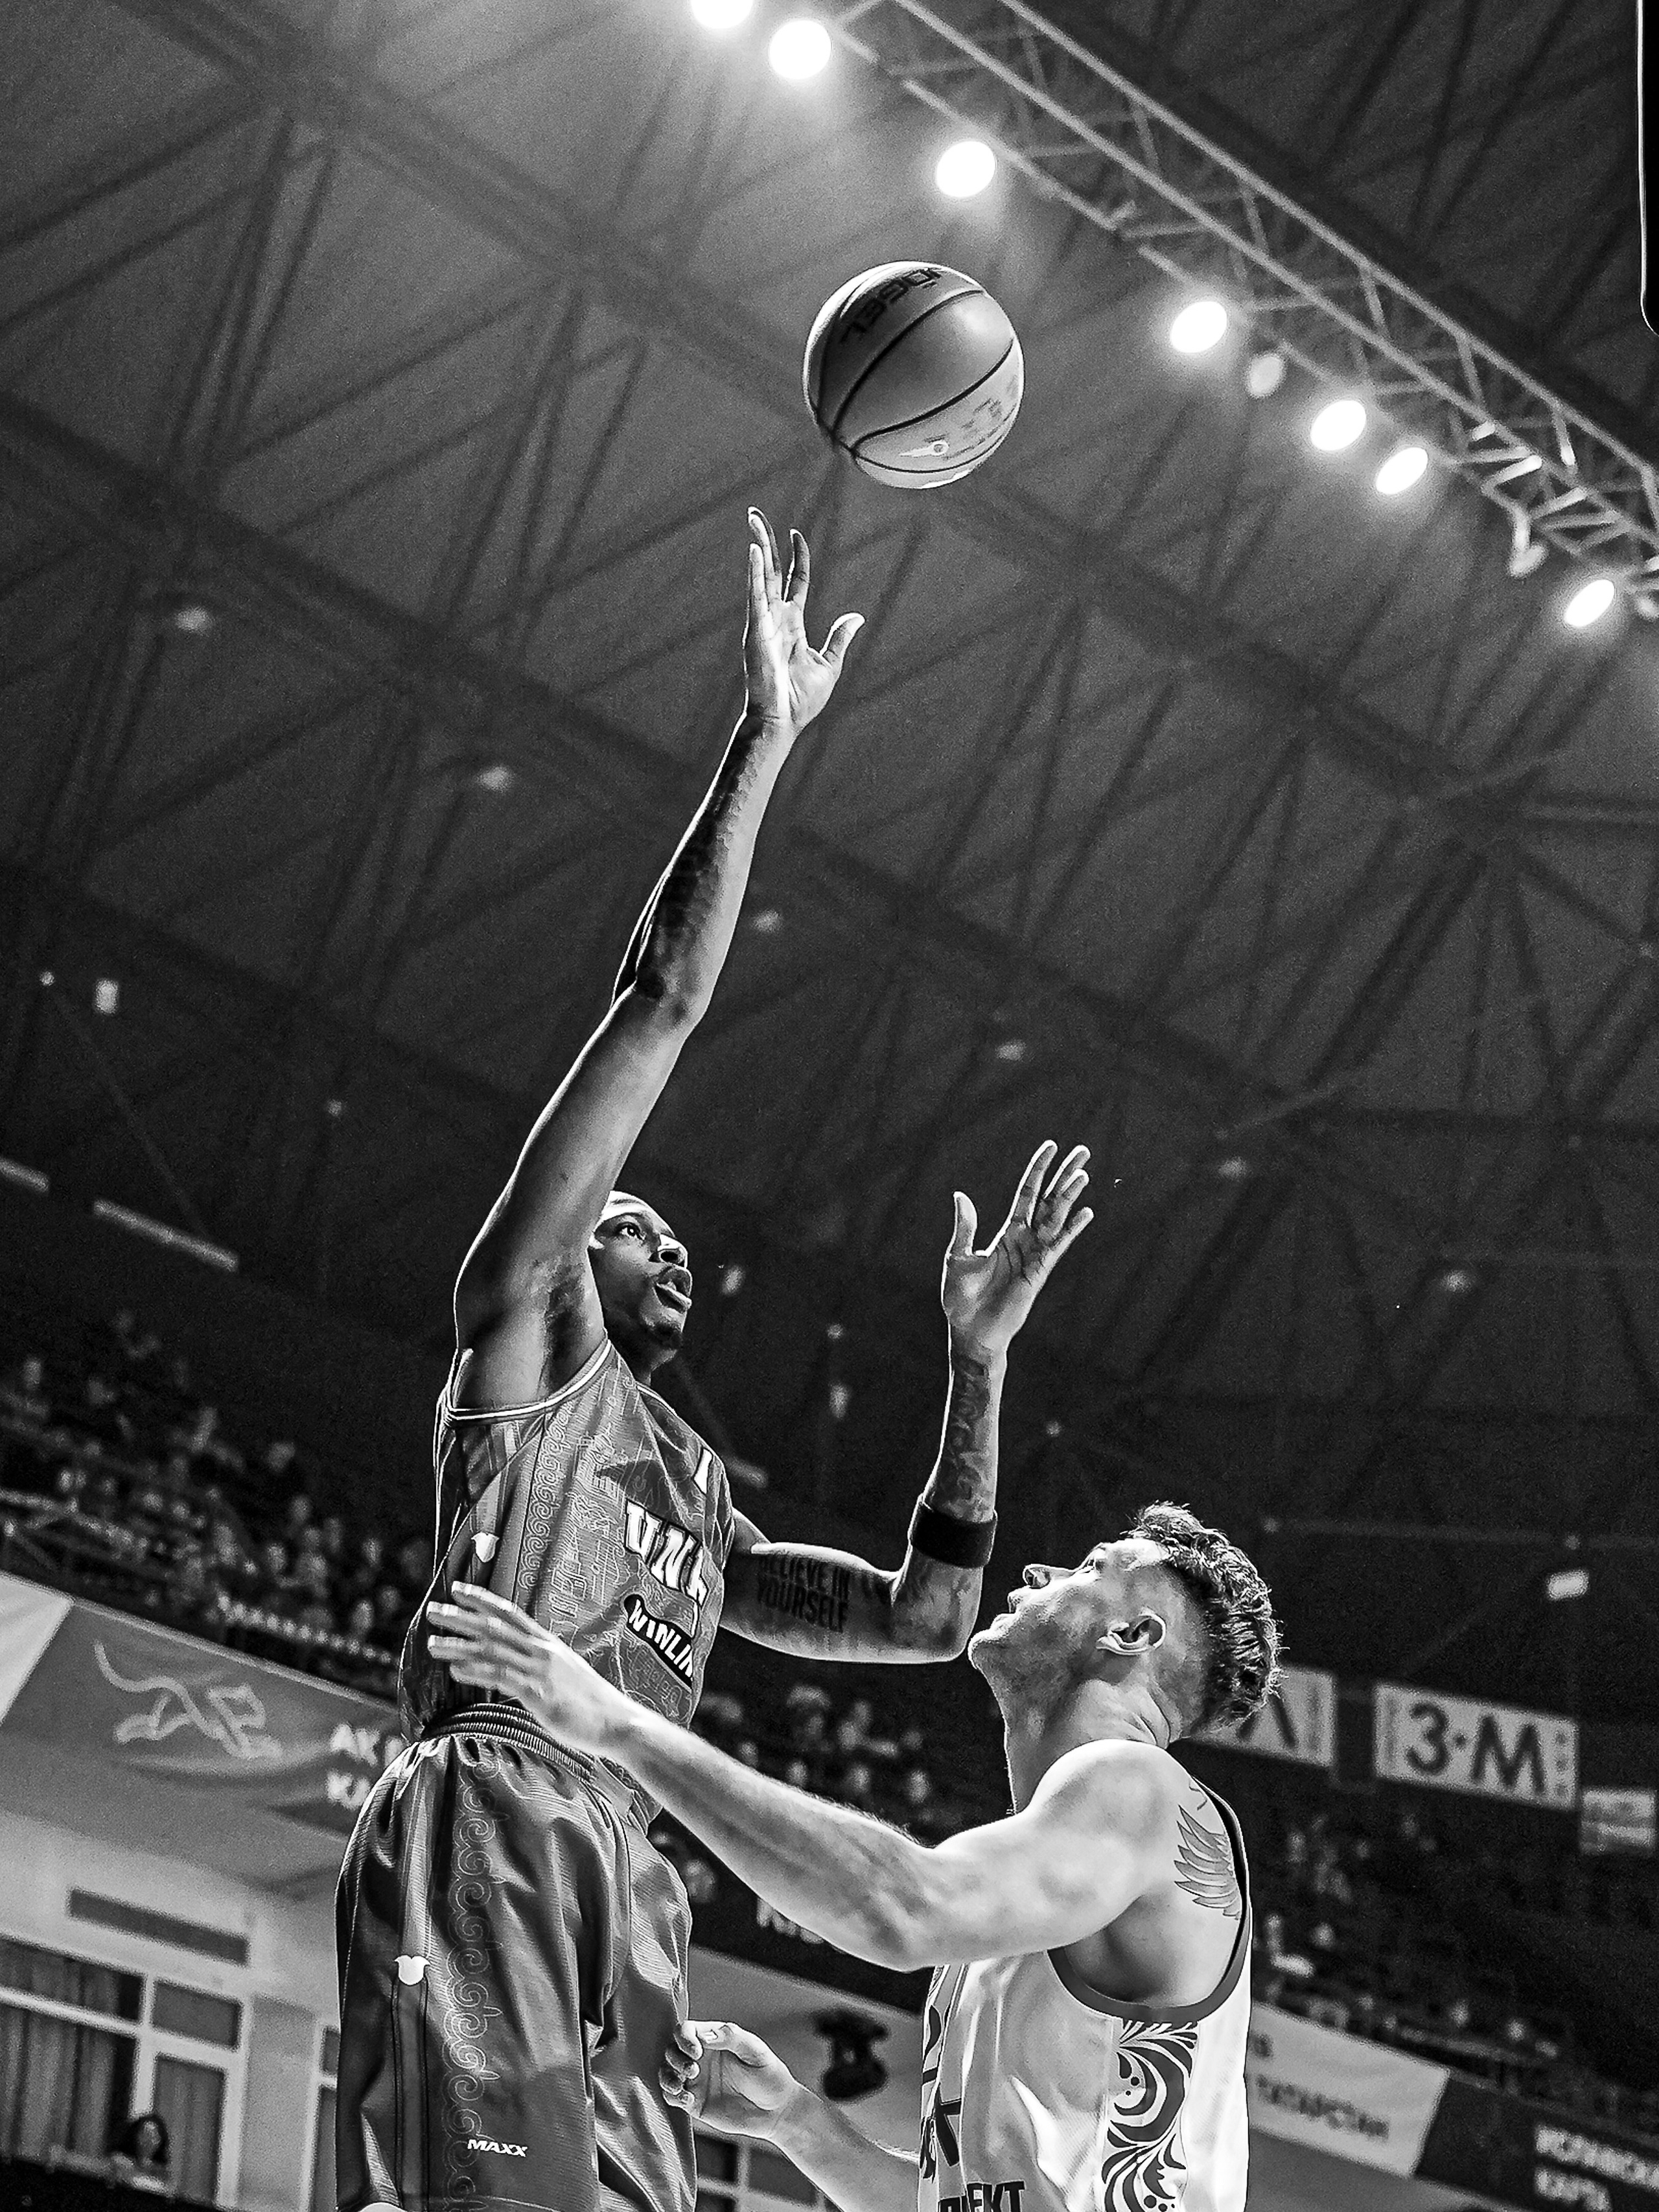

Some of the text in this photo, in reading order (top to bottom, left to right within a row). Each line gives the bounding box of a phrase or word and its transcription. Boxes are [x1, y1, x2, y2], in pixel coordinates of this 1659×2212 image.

[832, 1565, 850, 1601] IN
[757, 1574, 849, 1633] YOURSELF
[467, 2139, 528, 2158] MAXX
